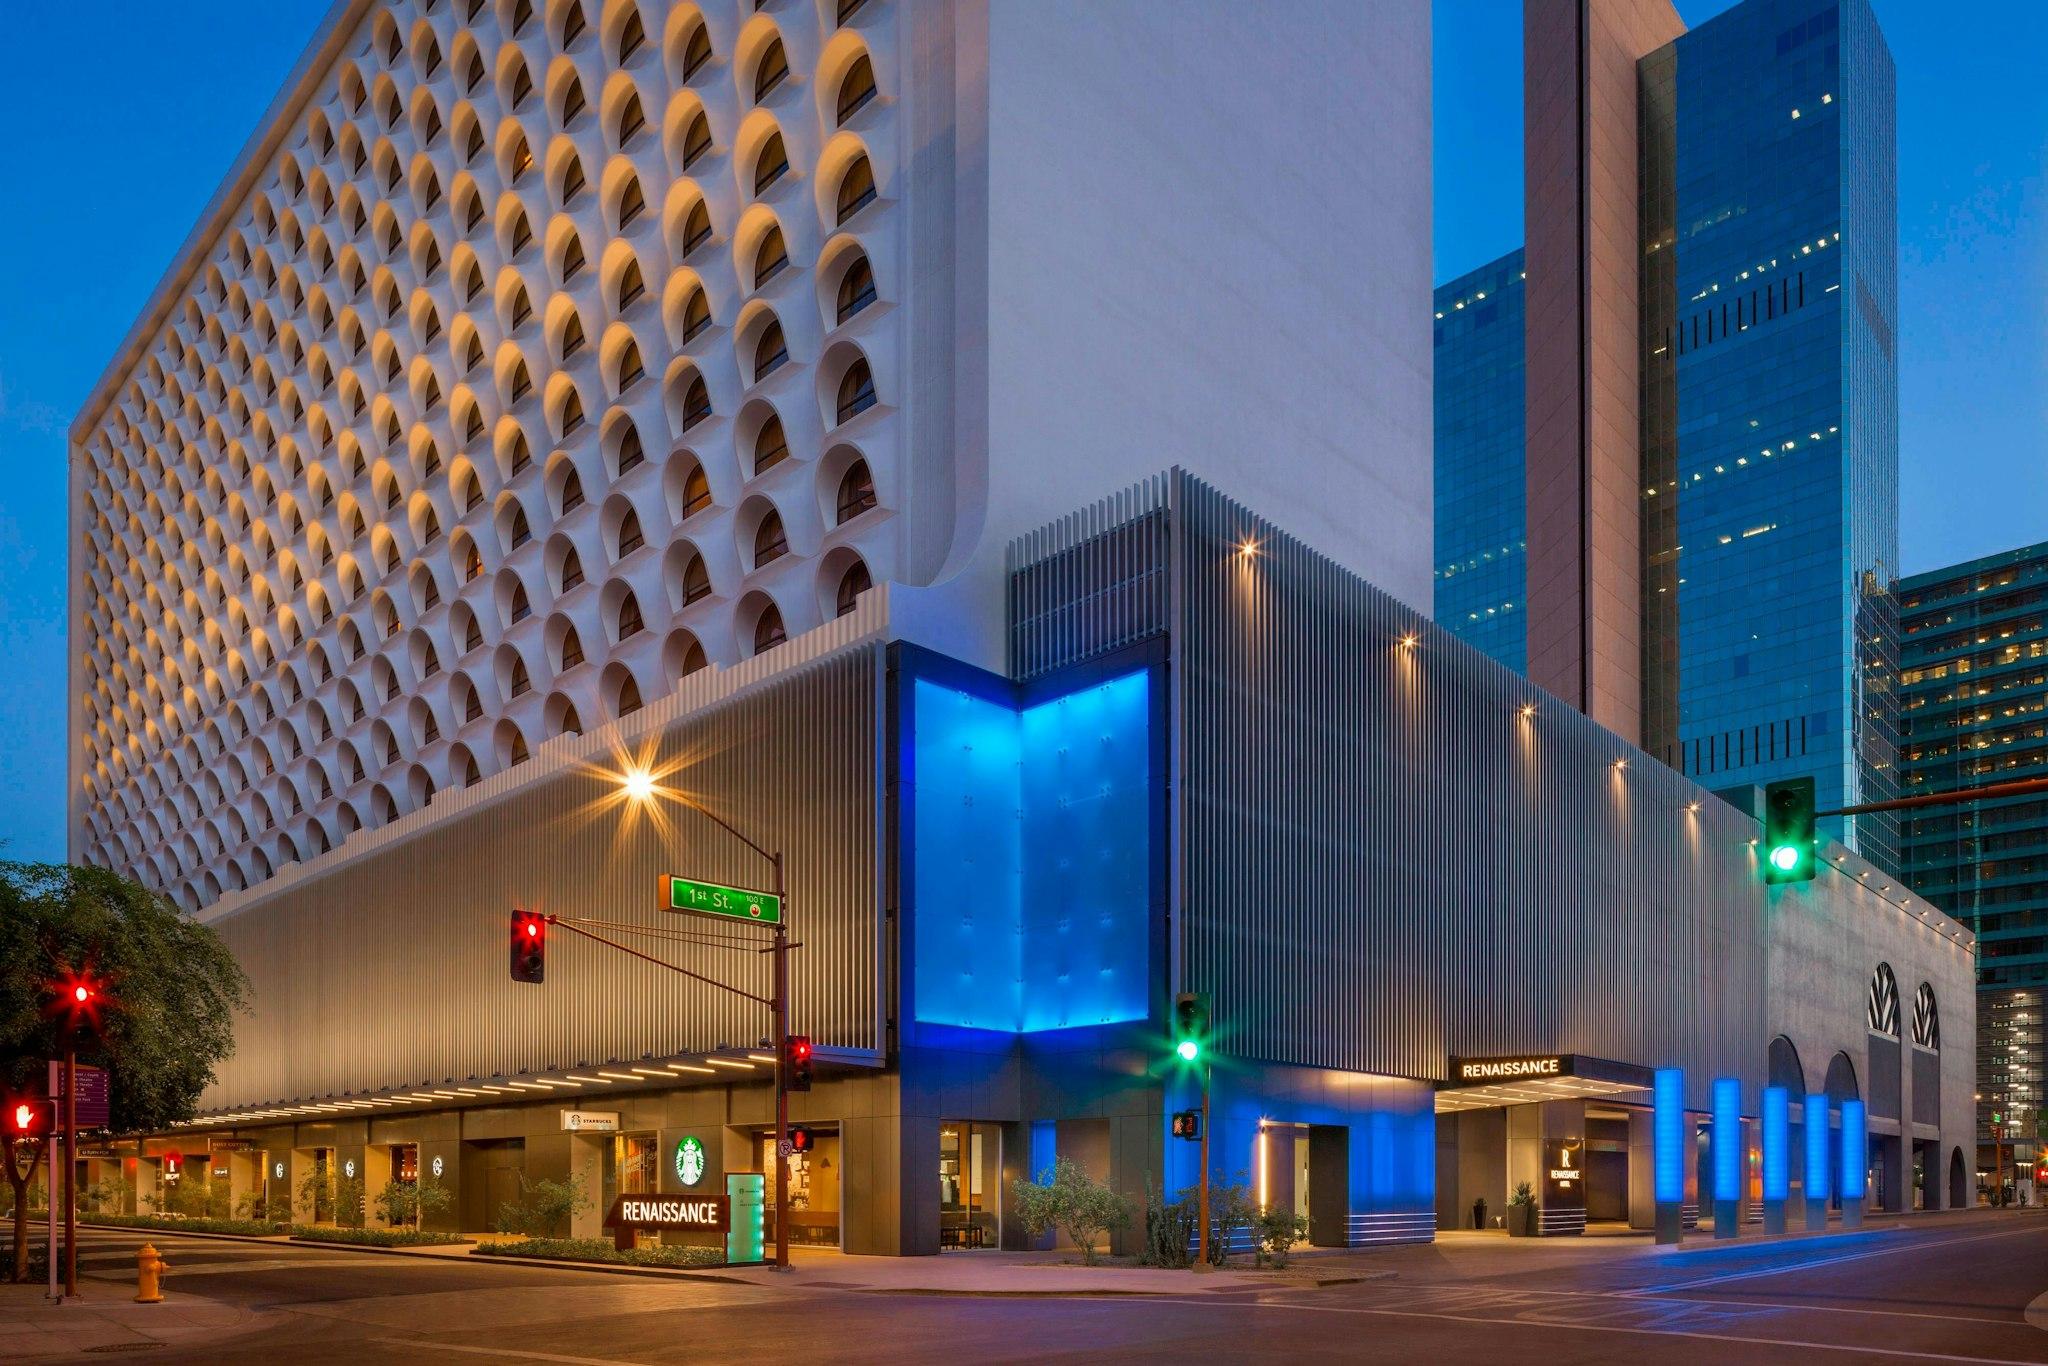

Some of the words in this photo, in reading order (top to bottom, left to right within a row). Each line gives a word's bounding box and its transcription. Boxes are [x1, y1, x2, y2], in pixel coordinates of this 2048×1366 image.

[689, 888, 707, 903] 1st
[713, 892, 733, 909] St.
[746, 895, 758, 904] 100
[1463, 1060, 1559, 1078] RENAISSANCE
[1561, 1149, 1571, 1168] R
[1551, 1170, 1580, 1180] RENAISSANCE
[623, 1201, 718, 1224] RENAISSANCE
